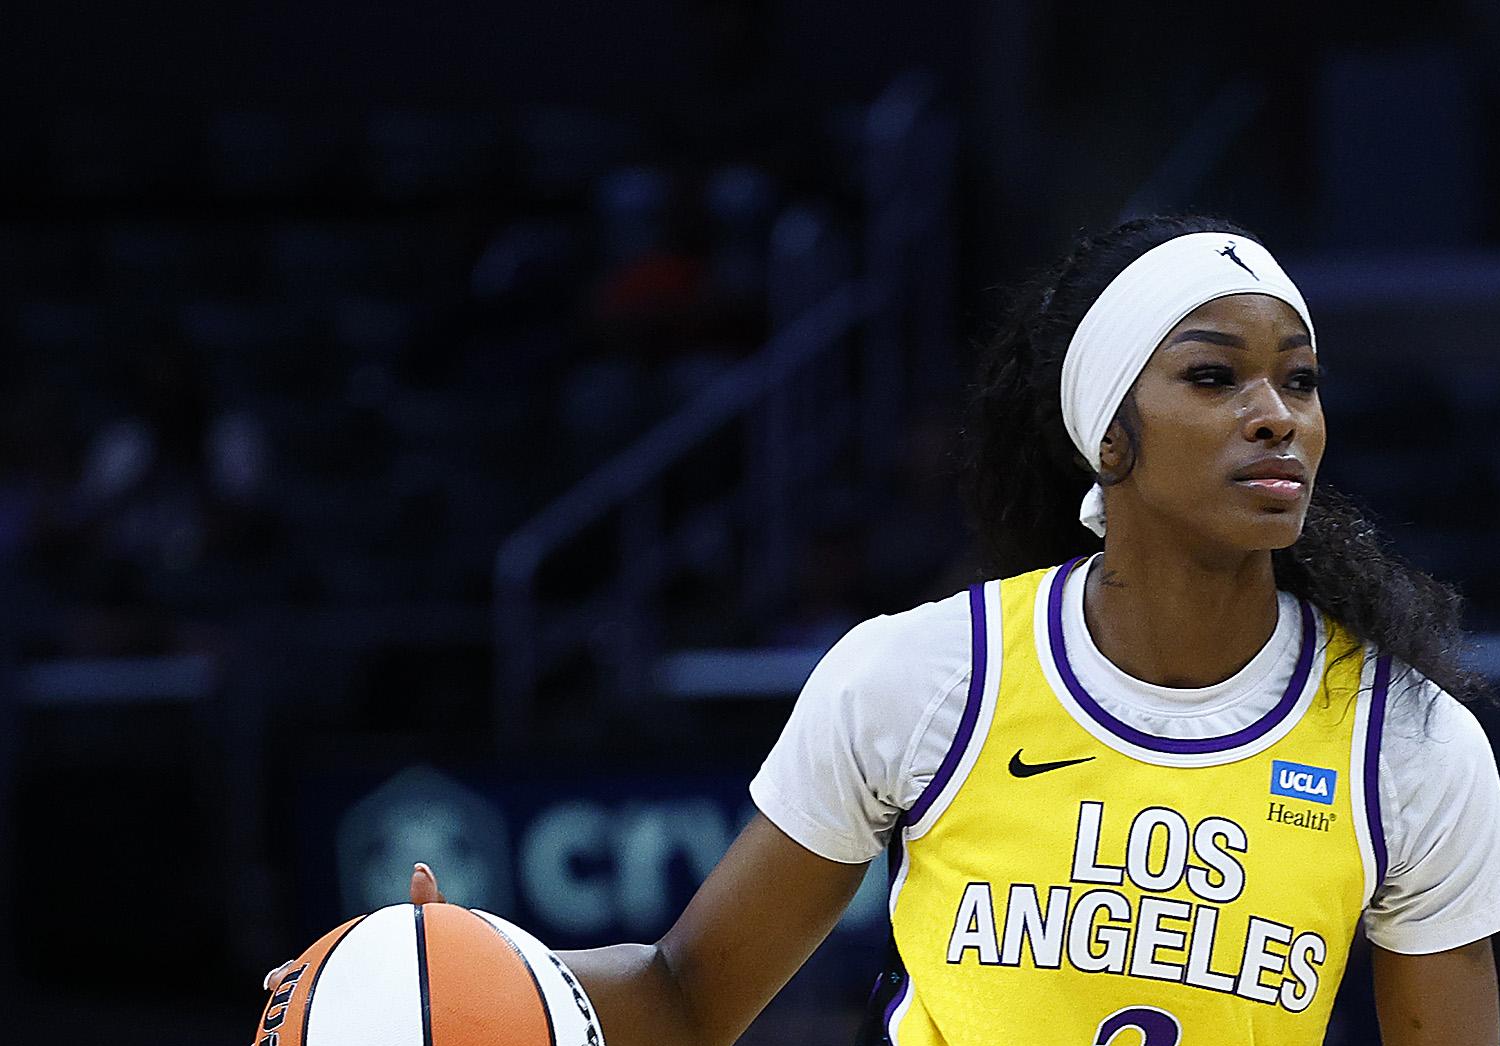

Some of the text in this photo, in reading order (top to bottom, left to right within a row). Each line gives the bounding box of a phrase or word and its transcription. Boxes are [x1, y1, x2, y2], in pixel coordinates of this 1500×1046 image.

[1279, 769, 1328, 797] UCLA
[1071, 801, 1248, 902] LOS
[946, 882, 1327, 1013] ANGELES
